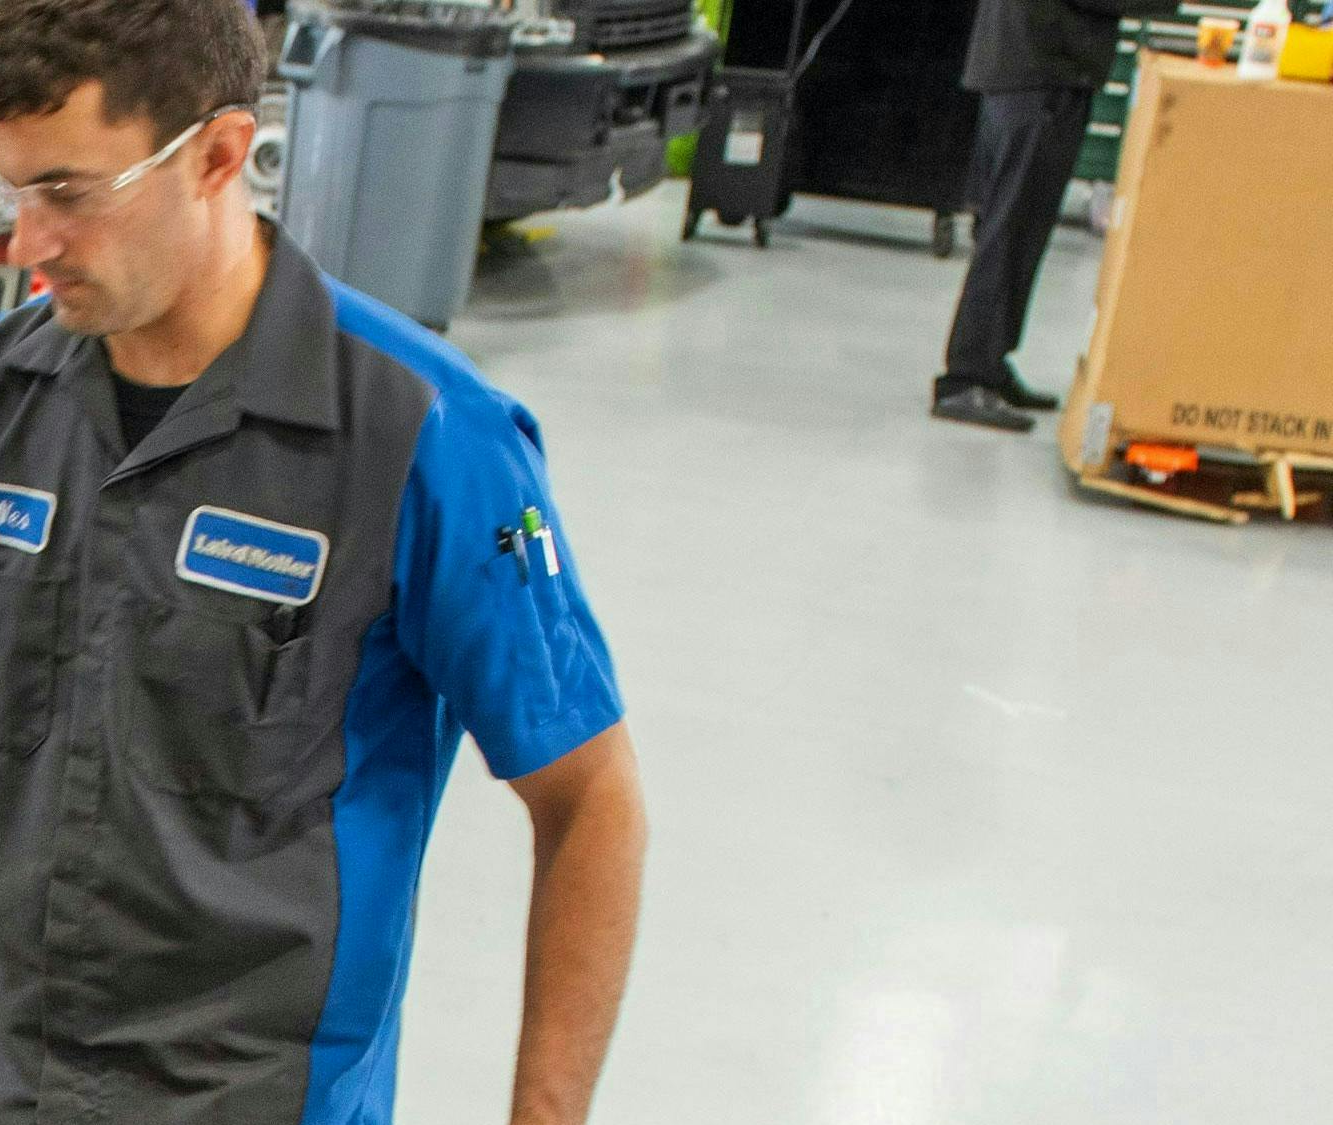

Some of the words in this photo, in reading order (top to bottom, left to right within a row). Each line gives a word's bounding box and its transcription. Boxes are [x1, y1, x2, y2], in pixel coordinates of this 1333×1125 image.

[1172, 402, 1199, 426] DO
[1204, 406, 1242, 431] NOT
[1247, 410, 1306, 436] STACK
